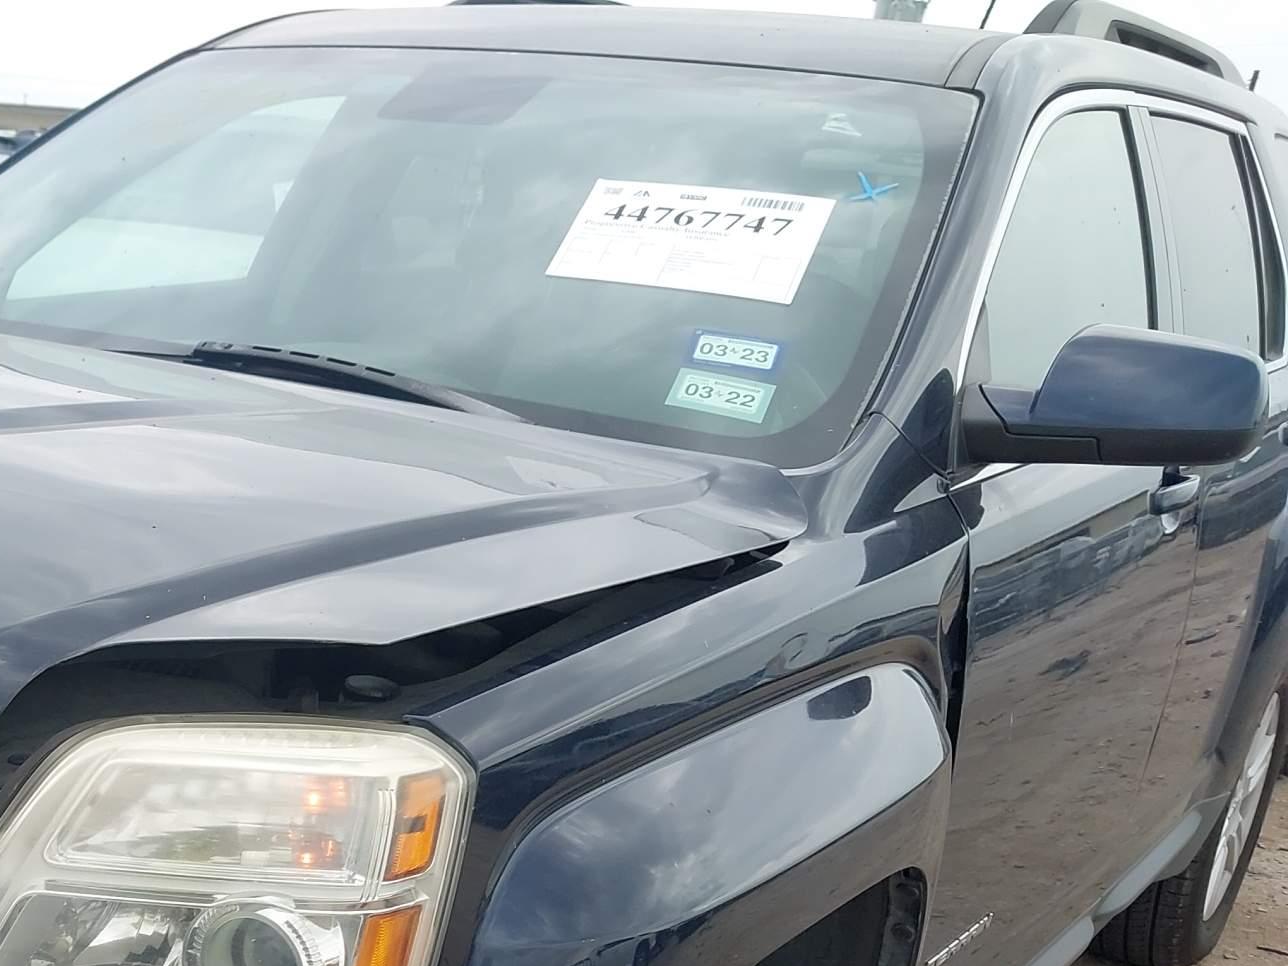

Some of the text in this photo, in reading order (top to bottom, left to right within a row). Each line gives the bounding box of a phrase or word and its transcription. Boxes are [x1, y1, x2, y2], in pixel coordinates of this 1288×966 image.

[604, 203, 794, 237] 44767747
[699, 342, 729, 357] 03
[740, 347, 770, 363] 23
[685, 383, 714, 399] 03
[725, 391, 756, 408] 22
